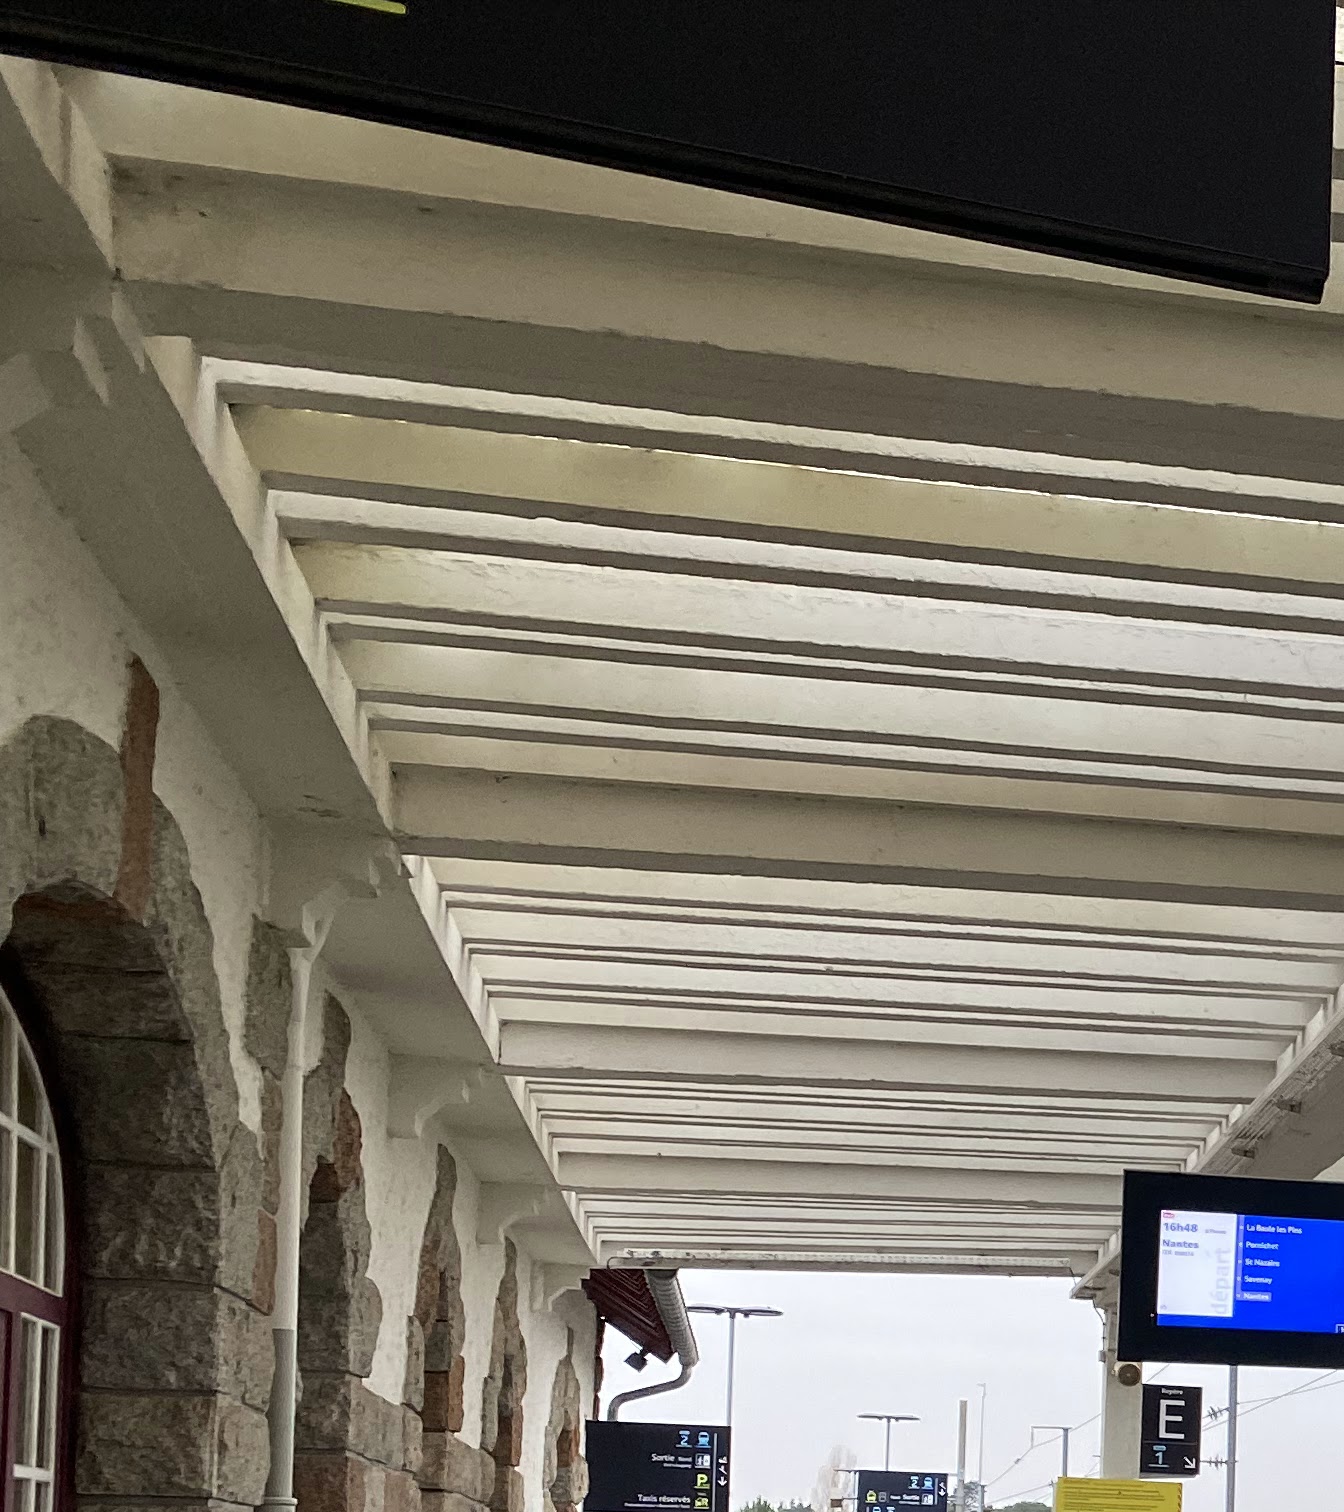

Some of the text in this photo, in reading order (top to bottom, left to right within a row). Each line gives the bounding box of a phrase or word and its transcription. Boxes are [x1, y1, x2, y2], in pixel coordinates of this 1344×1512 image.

[1162, 1222, 1199, 1233] 16h48
[1162, 1238, 1200, 1249] Nantes
[1158, 1398, 1186, 1440] E
[680, 1435, 688, 1446] 2
[651, 1453, 675, 1462] Sortie
[1154, 1451, 1163, 1465] 1
[696, 1473, 708, 1486] P
[637, 1493, 658, 1503] Taxis
